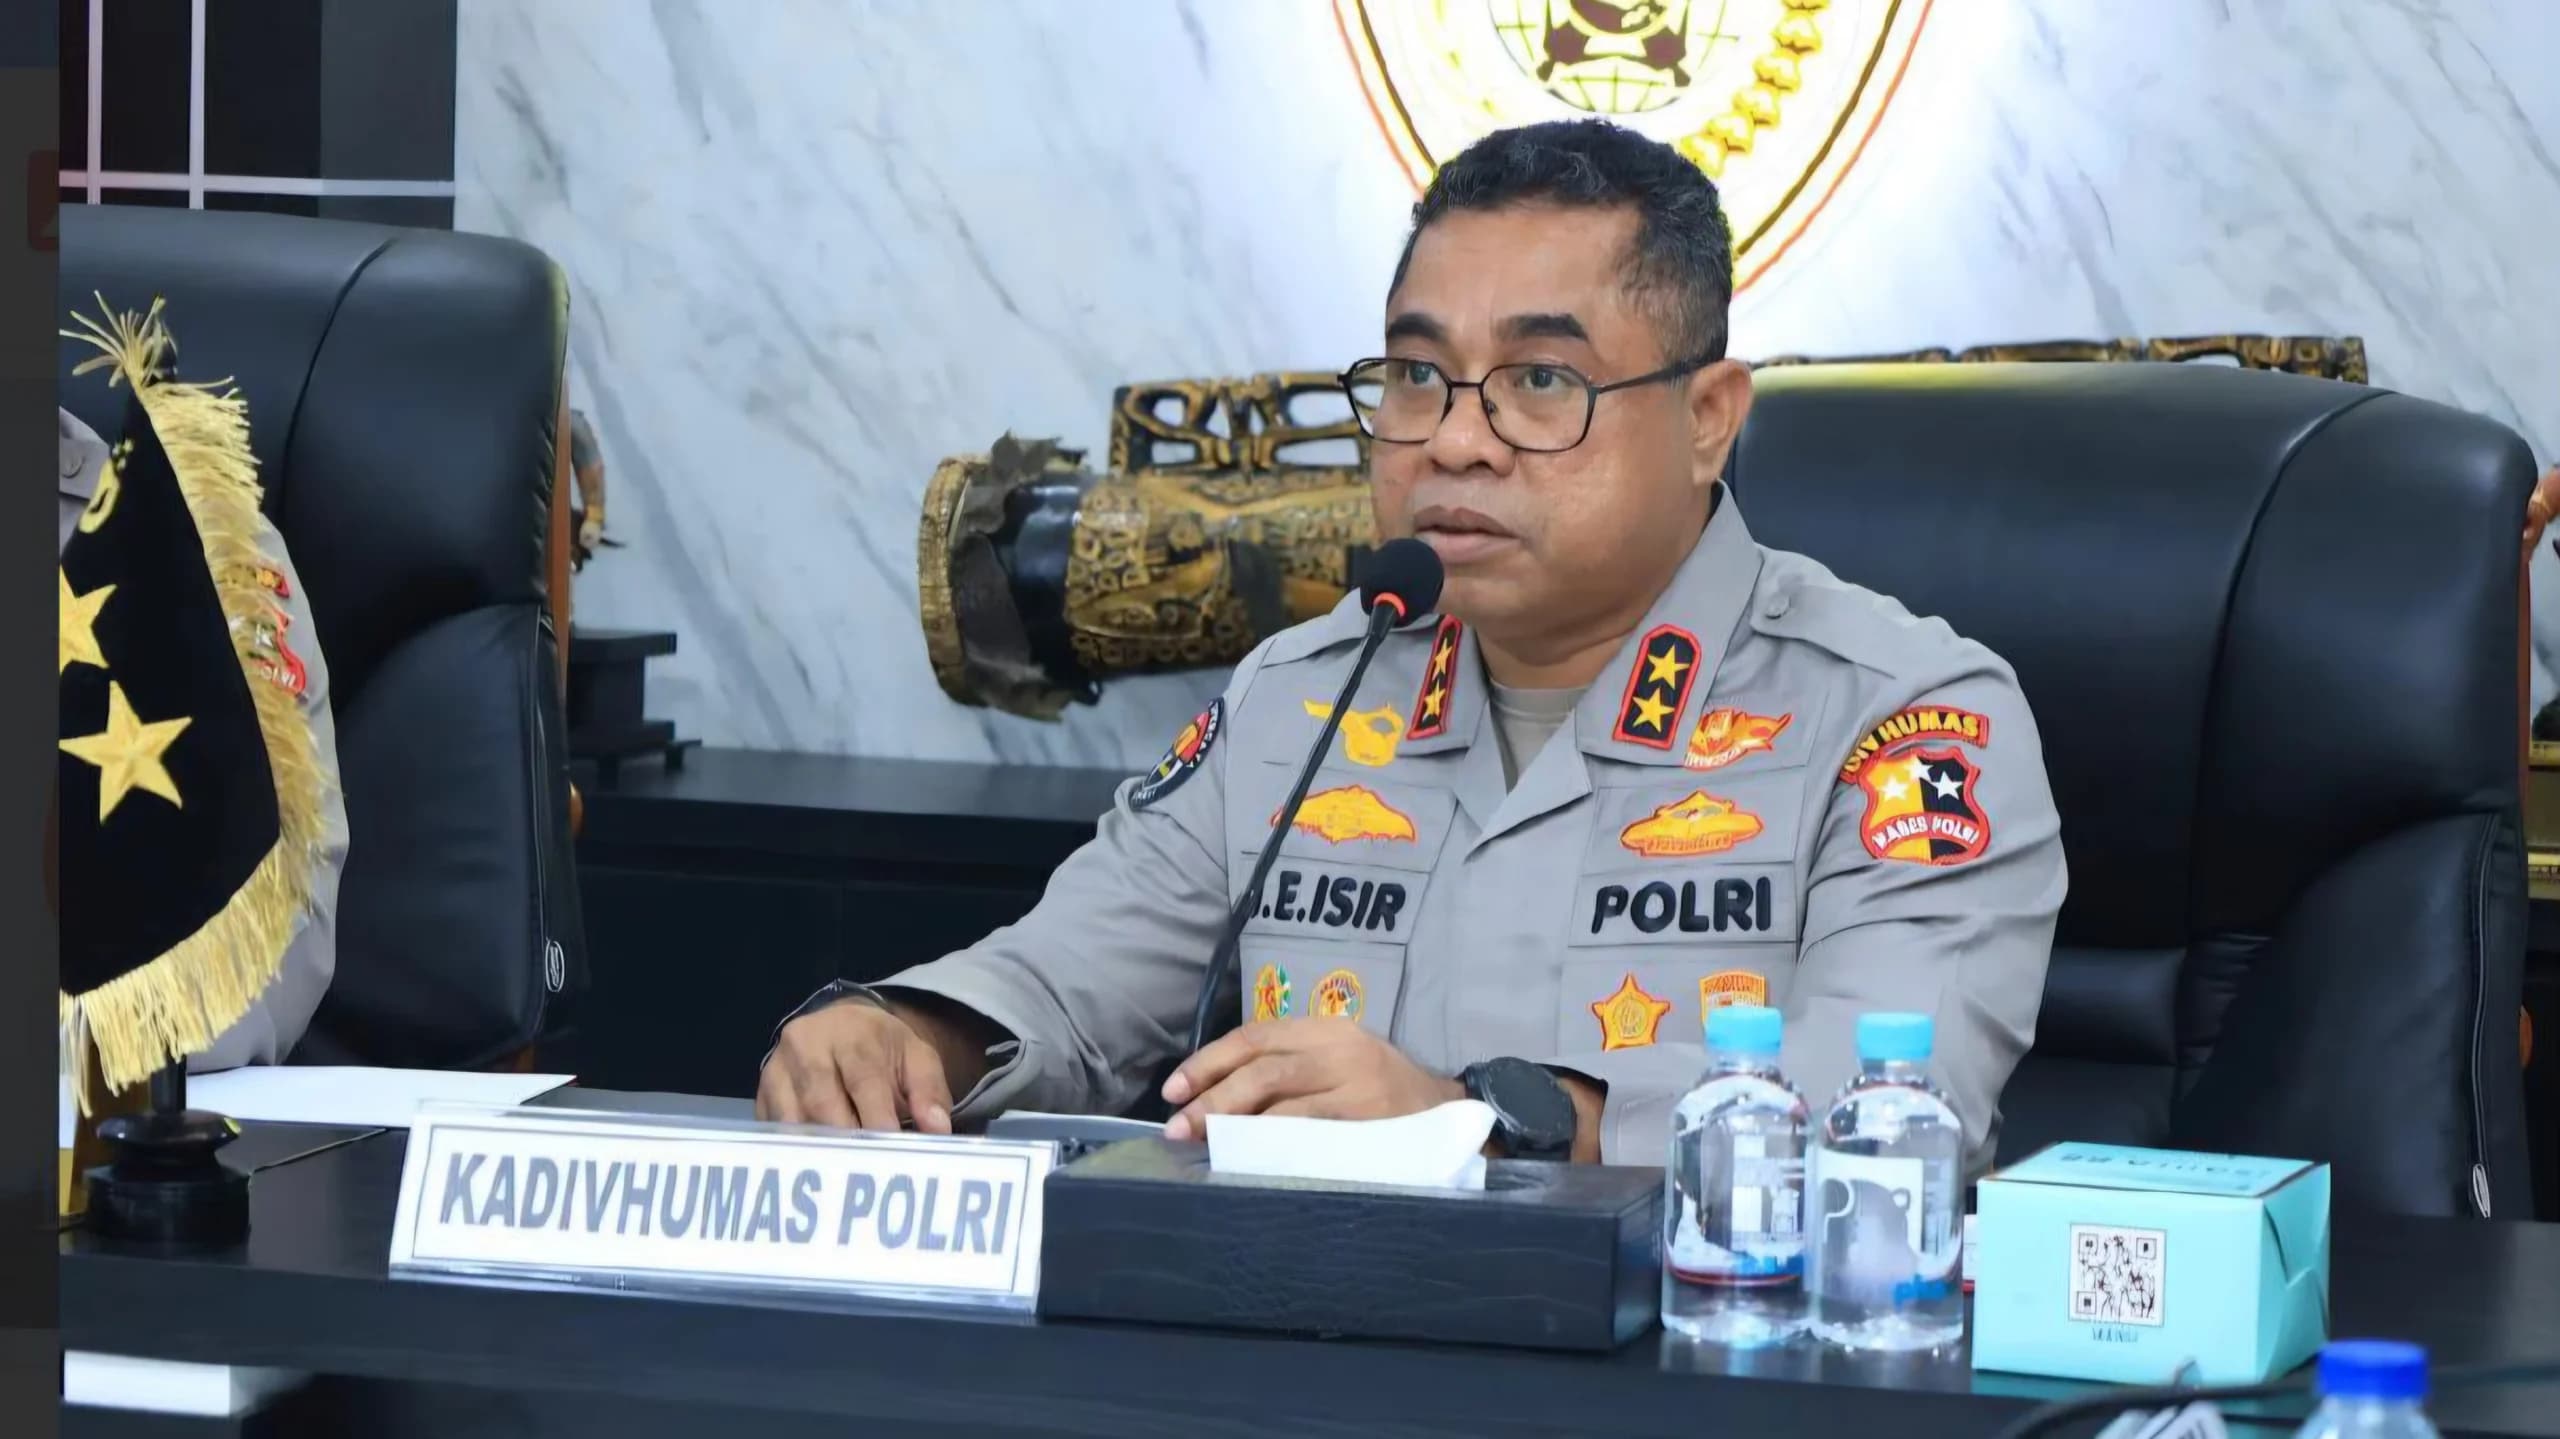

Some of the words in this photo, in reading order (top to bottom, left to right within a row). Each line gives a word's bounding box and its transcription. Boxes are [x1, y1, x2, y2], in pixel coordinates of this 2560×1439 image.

[1931, 816, 1980, 845] POLRI
[1591, 876, 1771, 934] POLRI
[439, 1152, 821, 1244] KADIVHUMAS
[837, 1172, 1013, 1255] POLRI
